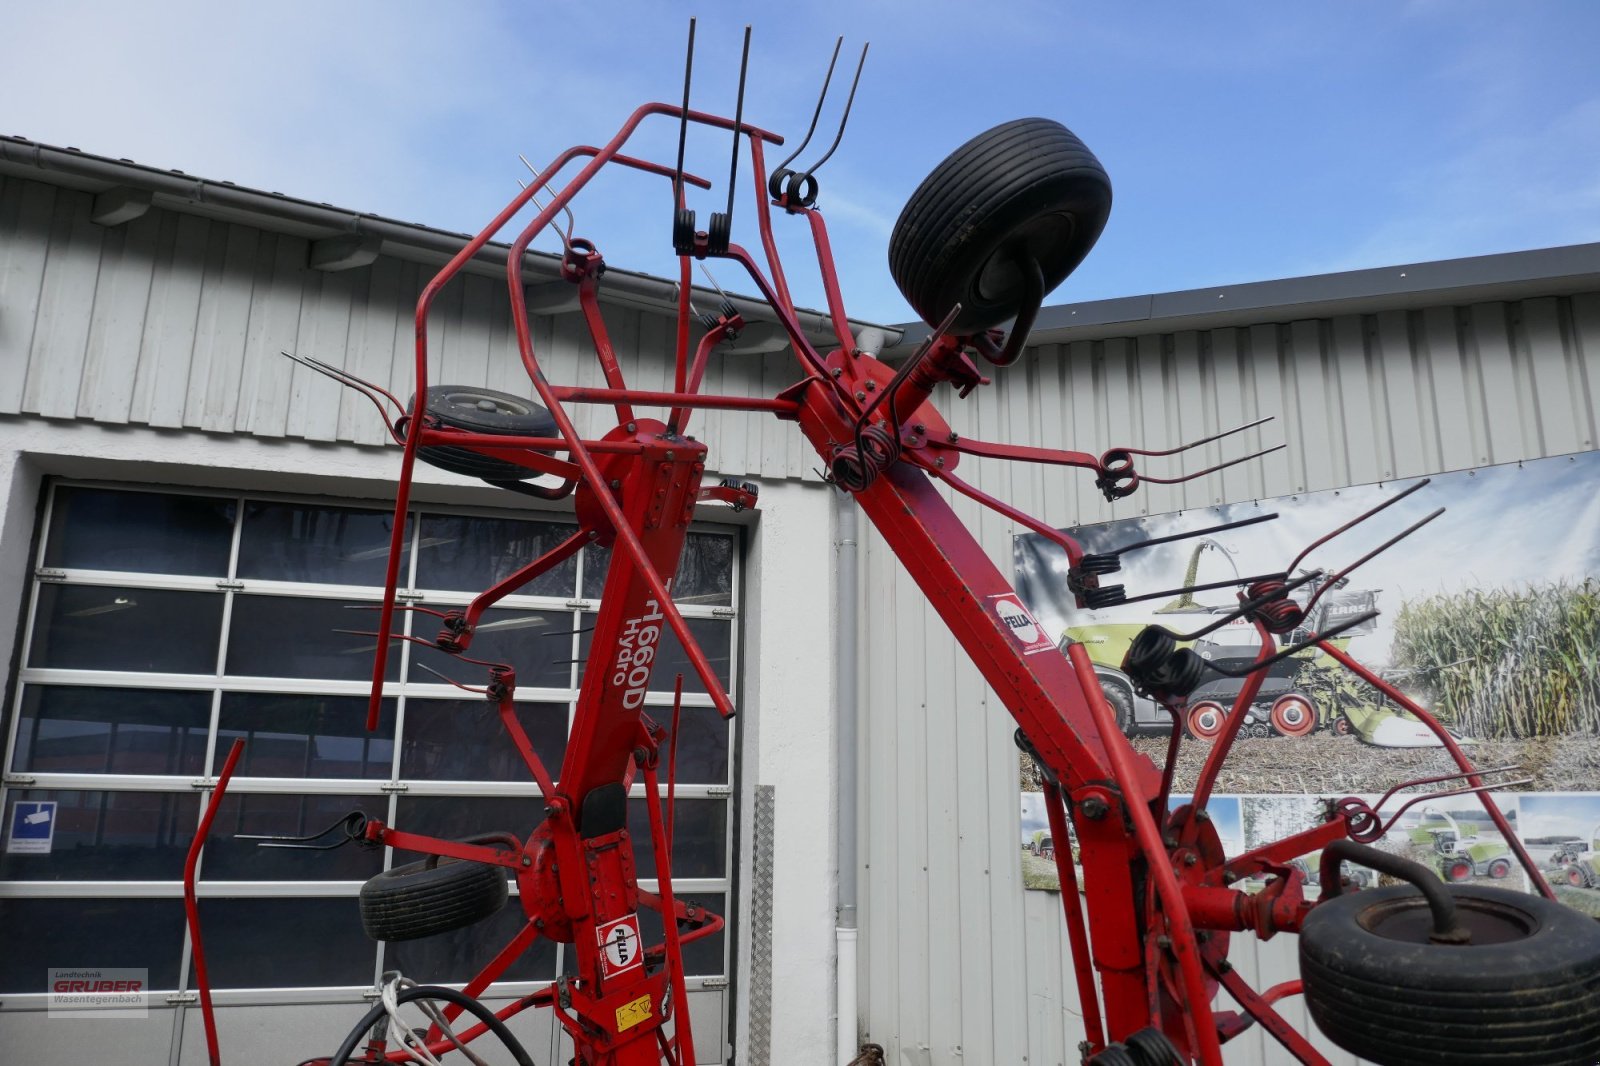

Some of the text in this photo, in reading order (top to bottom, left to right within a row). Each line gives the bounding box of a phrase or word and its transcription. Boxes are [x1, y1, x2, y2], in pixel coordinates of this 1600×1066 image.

[1004, 613, 1033, 629] FELLA
[613, 618, 642, 686] Hydro
[615, 928, 629, 965] FELLA
